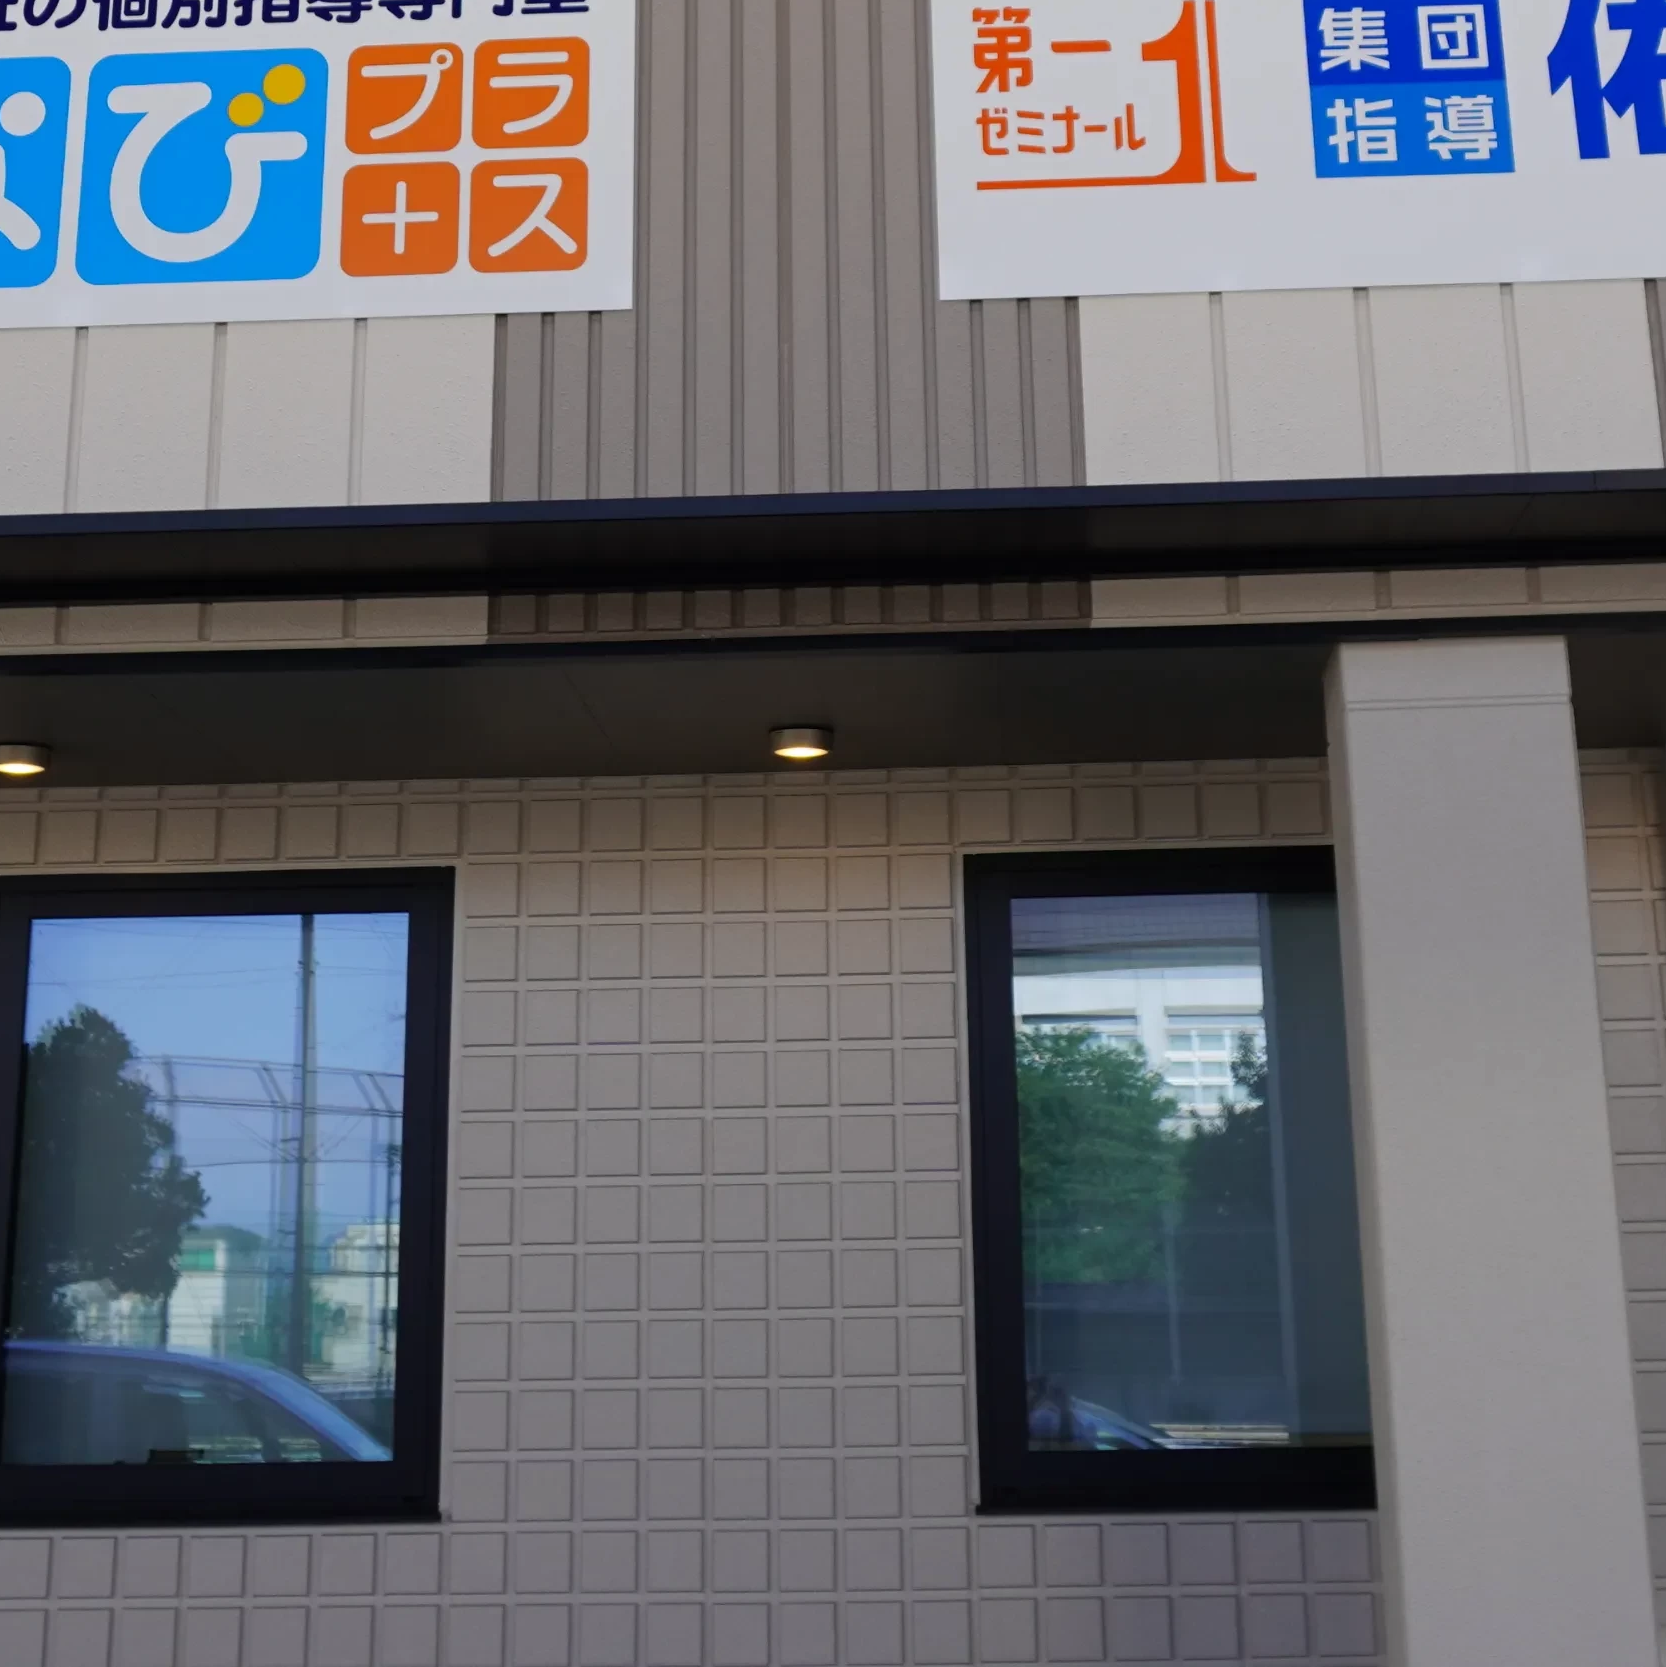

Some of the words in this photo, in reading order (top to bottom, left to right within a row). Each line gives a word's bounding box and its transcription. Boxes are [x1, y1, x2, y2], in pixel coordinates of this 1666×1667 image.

[971, 6, 1112, 94] 第一
[1317, 3, 1491, 72] 集団
[975, 103, 1147, 157] ゼミナール
[1326, 93, 1500, 164] 指導
